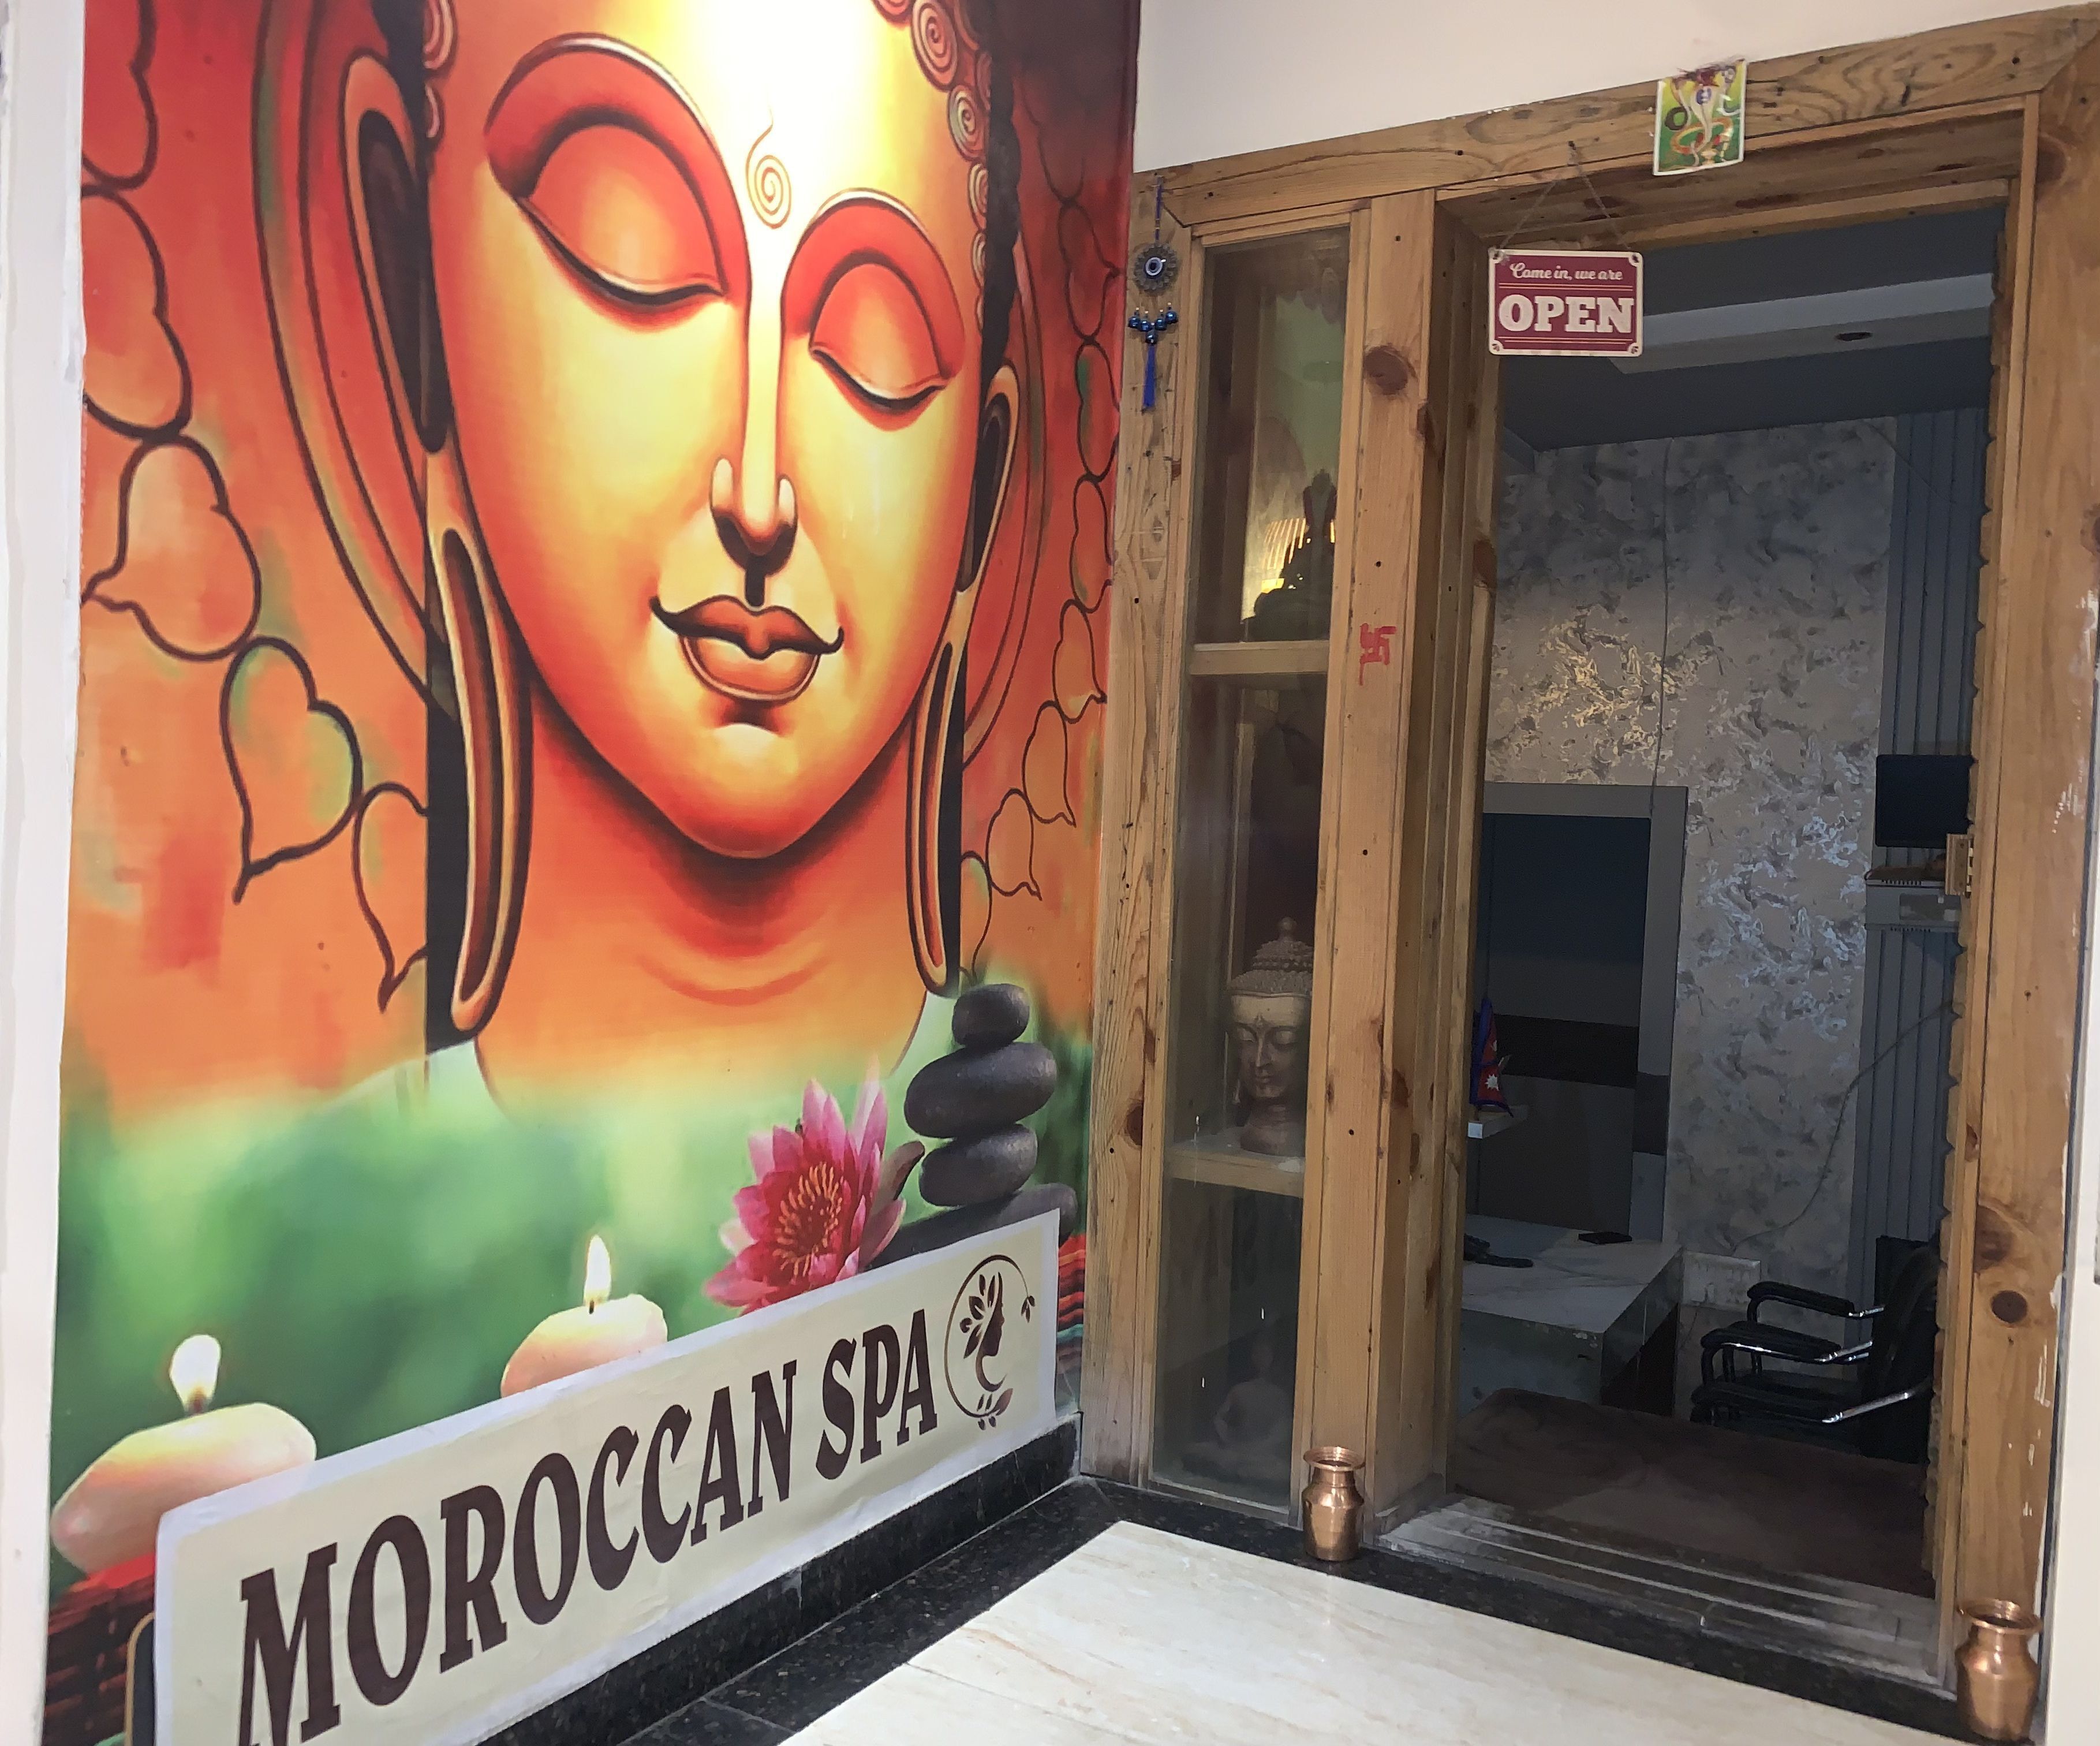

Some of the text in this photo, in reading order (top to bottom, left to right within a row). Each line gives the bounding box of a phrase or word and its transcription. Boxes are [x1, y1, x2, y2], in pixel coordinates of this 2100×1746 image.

[1553, 265, 1572, 281] in,
[1575, 271, 1597, 280] we
[1597, 270, 1623, 281] are
[1499, 294, 1634, 333] OPEN
[239, 1309, 937, 1746] MOROCCAN SPA
